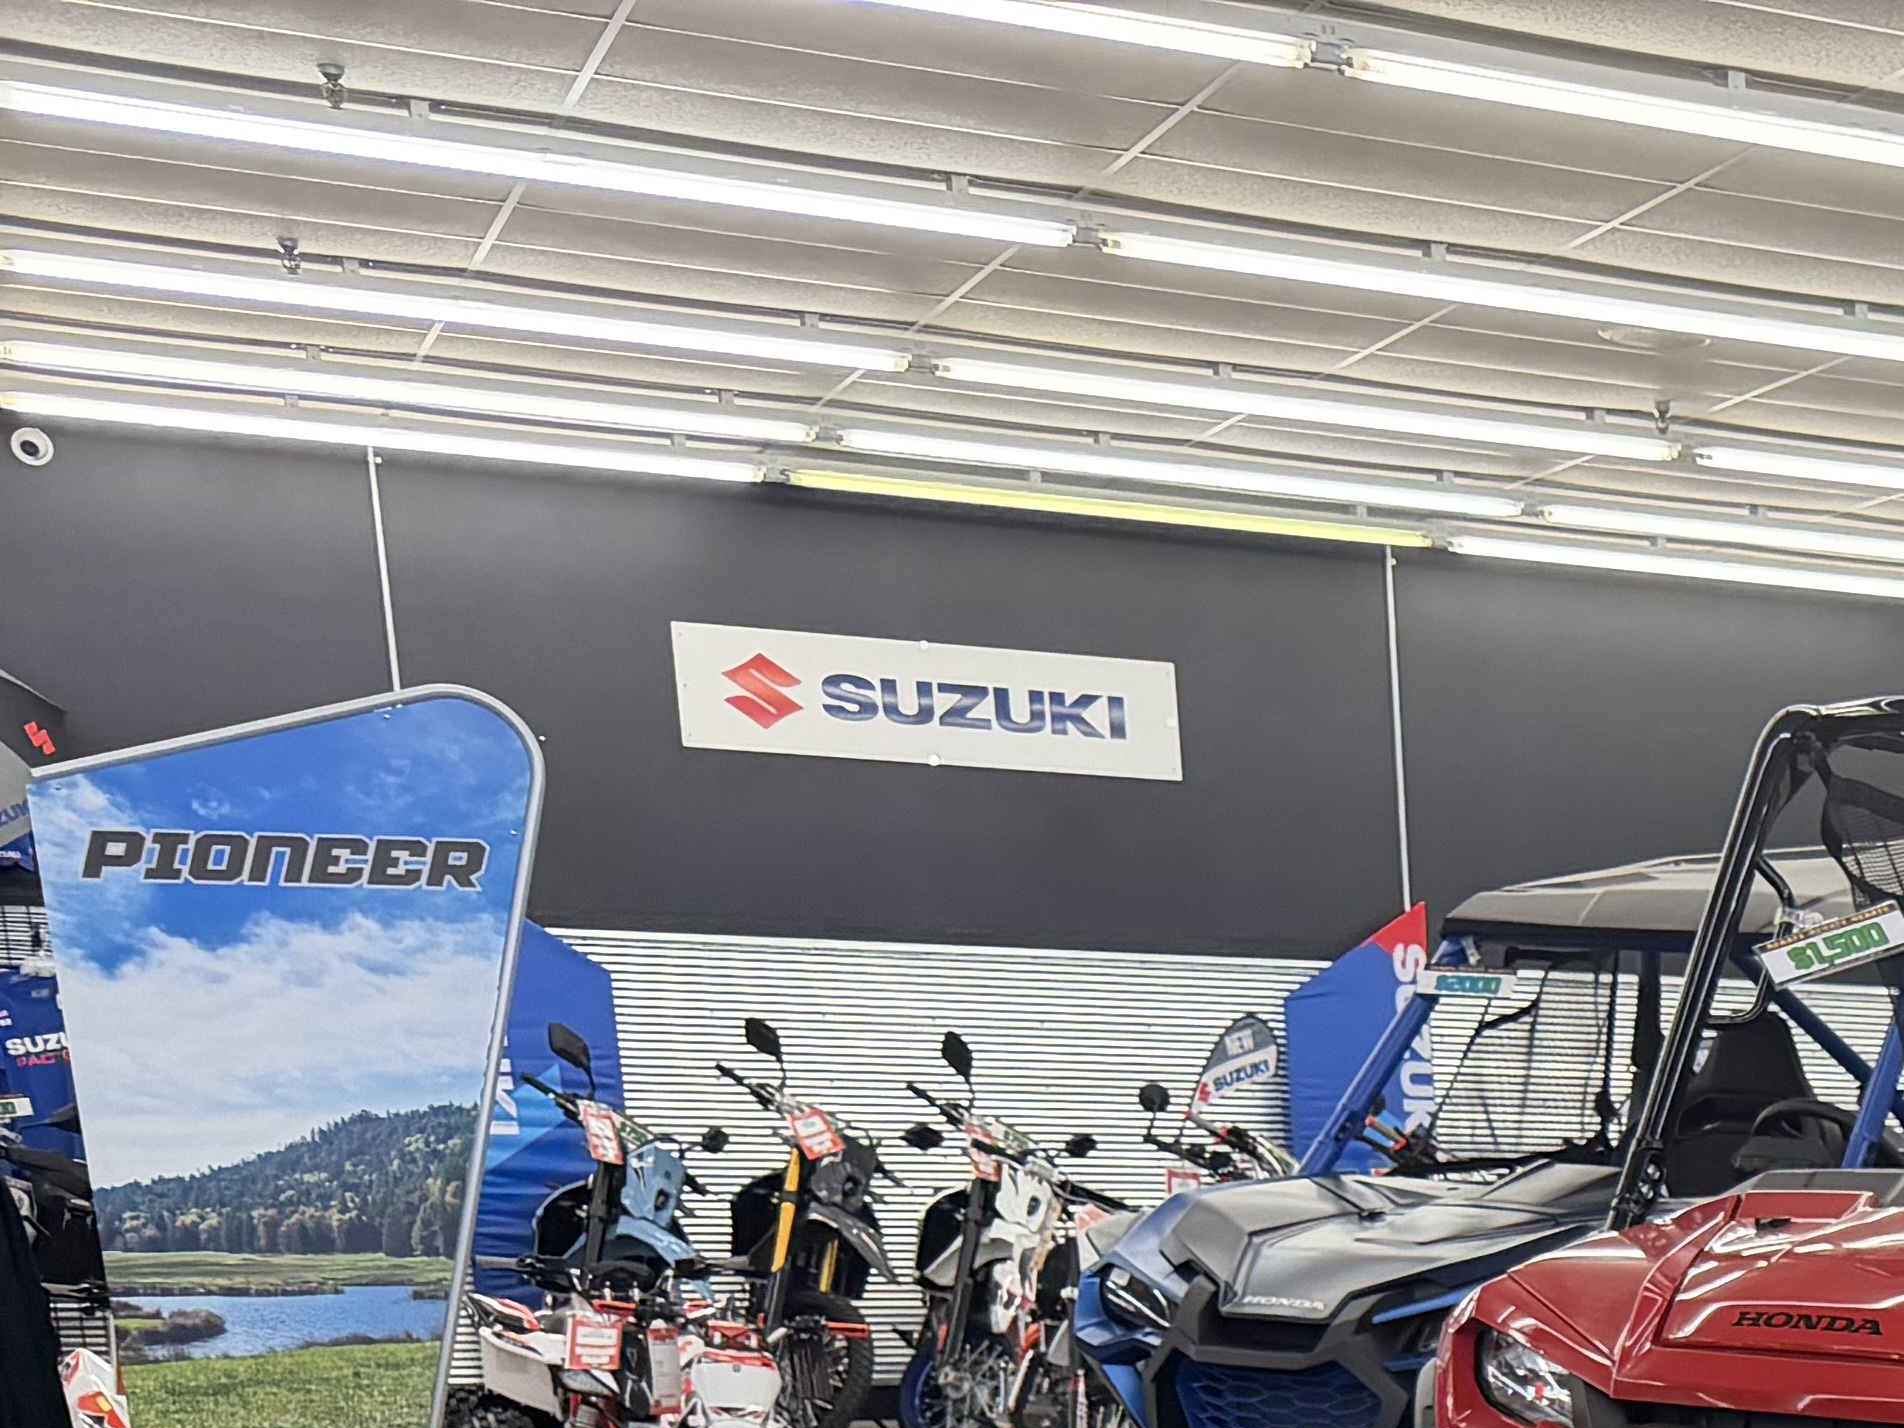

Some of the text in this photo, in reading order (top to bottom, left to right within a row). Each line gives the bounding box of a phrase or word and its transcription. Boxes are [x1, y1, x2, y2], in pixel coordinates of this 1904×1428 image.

[821, 673, 1128, 740] SUZUKI
[81, 829, 490, 891] PIONEER
[1786, 921, 1890, 971] $1,500
[1223, 1028, 1255, 1057] NEW
[1213, 1058, 1271, 1092] SUZUKI
[1732, 1311, 1883, 1336] HONDA
